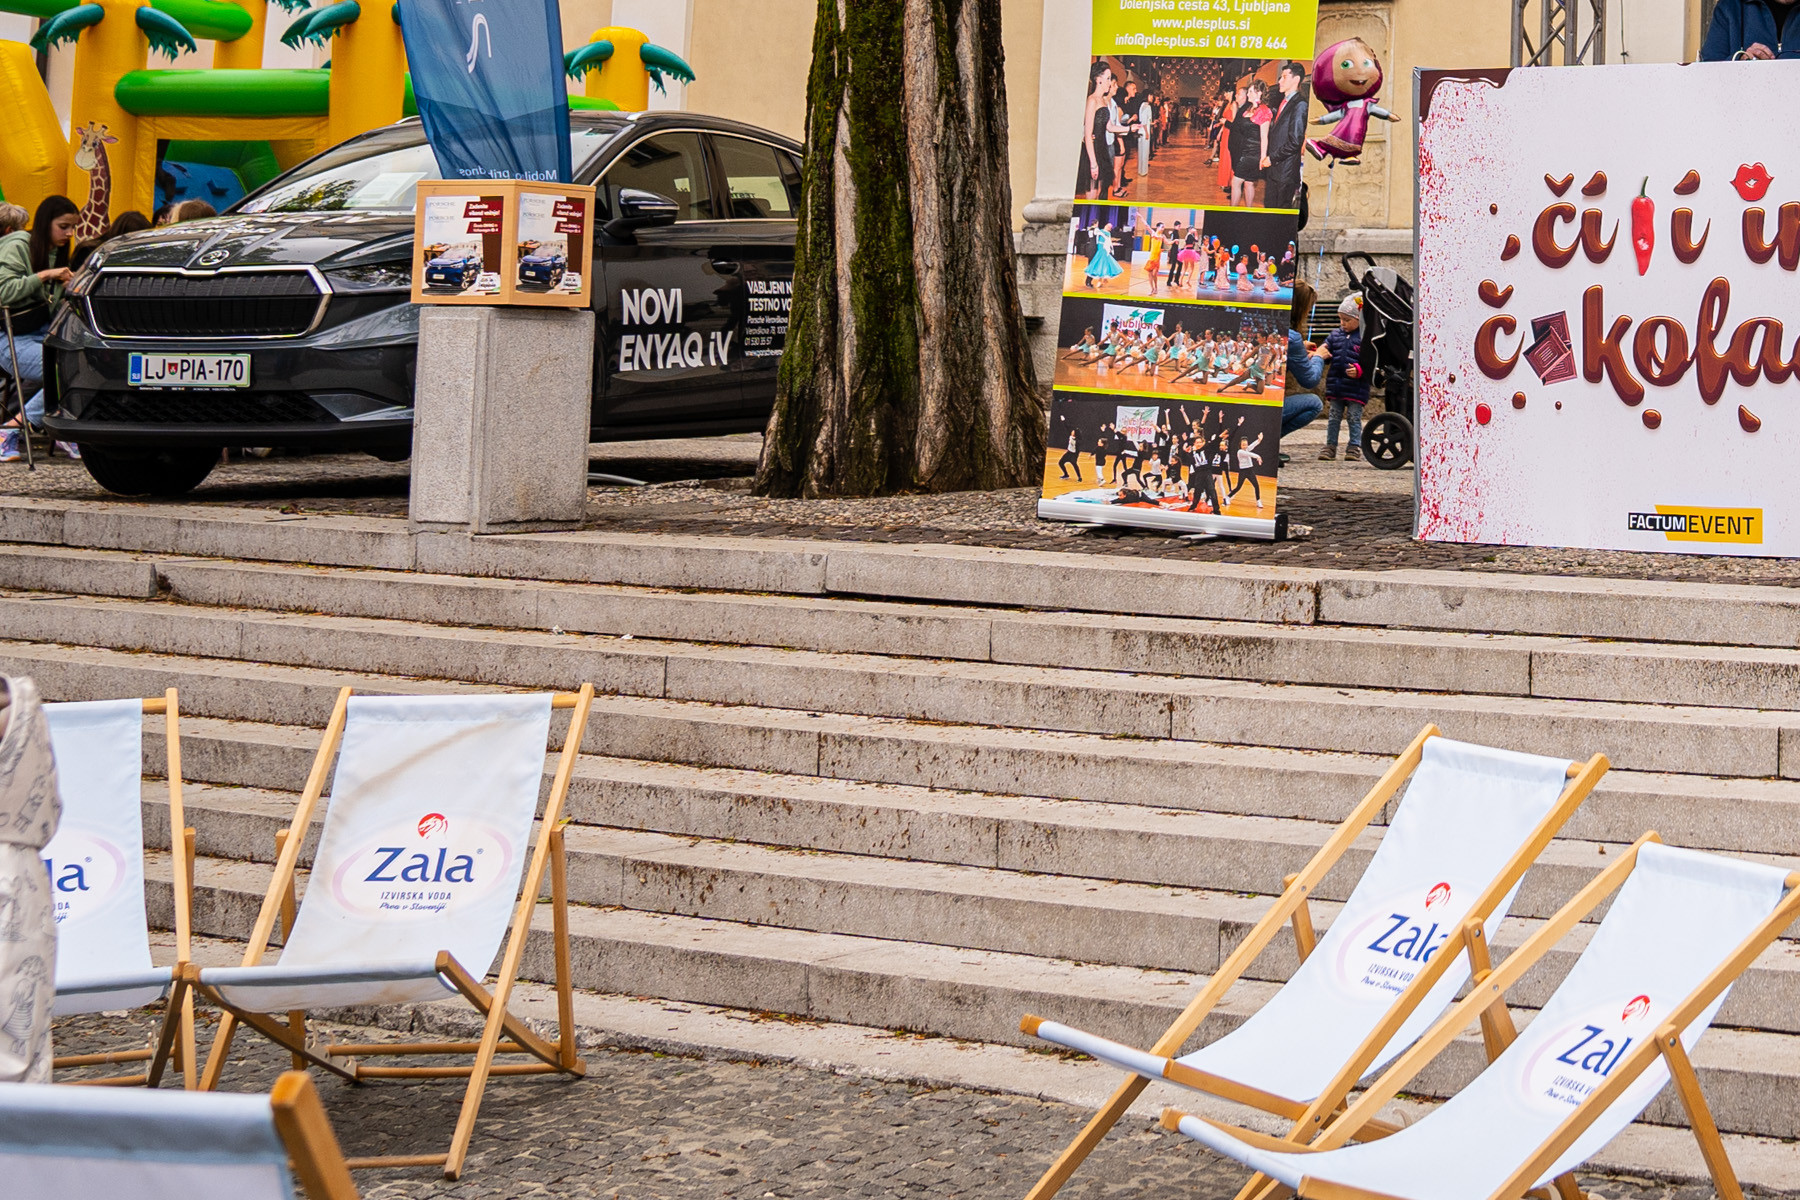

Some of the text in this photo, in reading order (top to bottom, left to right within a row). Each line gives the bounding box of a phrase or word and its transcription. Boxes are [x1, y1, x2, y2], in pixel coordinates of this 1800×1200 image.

[1178, 0, 1210, 12] cesta
[1213, 0, 1231, 14] 43,
[1234, 0, 1291, 15] Ljubljana
[1152, 17, 1251, 32] www.plesplus.si
[1115, 33, 1288, 50] info@plesplus.si 041 878 464
[746, 281, 793, 295] VABLJENI N
[622, 288, 683, 325] NOVI
[748, 298, 793, 312] TESTNO VO
[620, 332, 705, 372] ENYAQ
[145, 359, 166, 380] LJ
[180, 359, 244, 381] PIA-170
[380, 891, 451, 900] IZVIRSKA VODA
[1399, 971, 1415, 982] VOD
[1556, 1024, 1634, 1077] Zal
